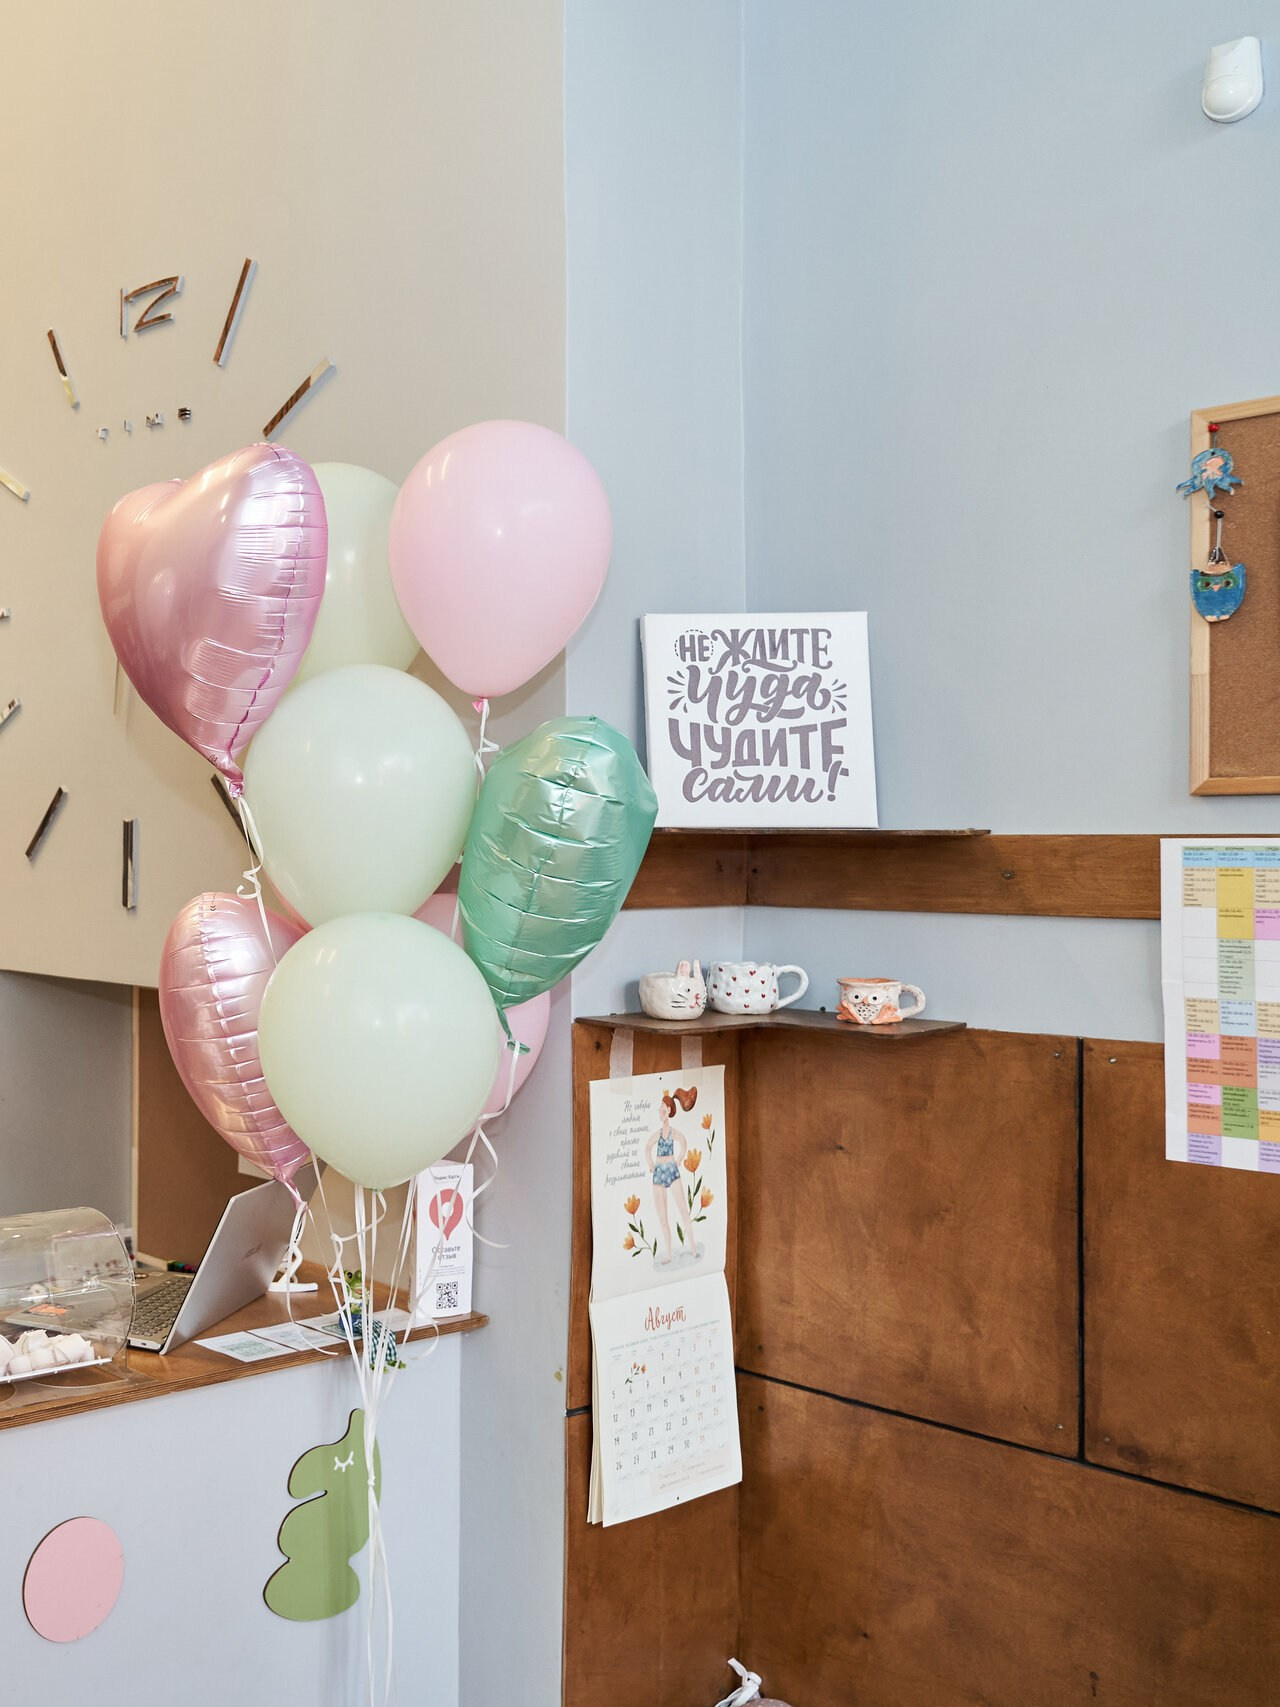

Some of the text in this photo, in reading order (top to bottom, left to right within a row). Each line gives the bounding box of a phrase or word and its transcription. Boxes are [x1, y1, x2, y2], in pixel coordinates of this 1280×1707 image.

[678, 628, 833, 674] НЕ ЖДИТЕ
[668, 718, 850, 776] ЧУДИТЕ
[644, 1305, 686, 1332] Август
[613, 1414, 618, 1423] 12
[663, 1399, 668, 1407] 15
[680, 1394, 685, 1403] 16
[632, 1431, 638, 1441] 20
[665, 1422, 672, 1431] 22
